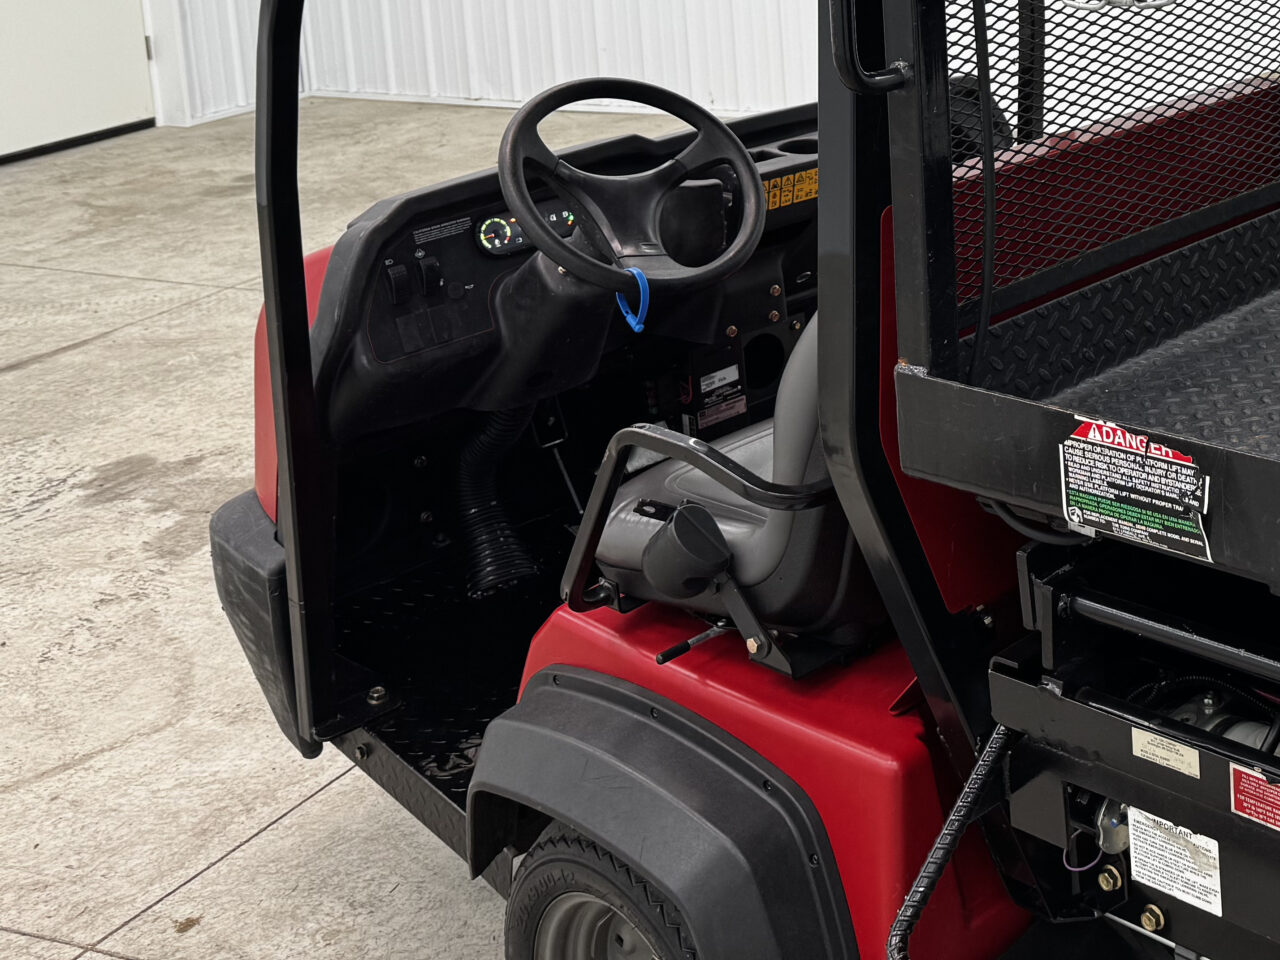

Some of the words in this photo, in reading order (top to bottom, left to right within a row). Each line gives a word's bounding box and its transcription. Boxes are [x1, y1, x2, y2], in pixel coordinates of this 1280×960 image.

[1064, 445, 1083, 456] CAUSE
[1084, 450, 1110, 462] SERIOUS
[1143, 465, 1166, 477] INJURY
[1166, 471, 1176, 479] OR
[1072, 455, 1094, 466] REDUCE
[1094, 461, 1108, 470] RISK
[1108, 464, 1116, 472] TO
[1116, 466, 1147, 480] OPERATOR
[1148, 474, 1160, 483] AND
[1167, 464, 1181, 472] LIFT
[1181, 467, 1194, 476] MAY
